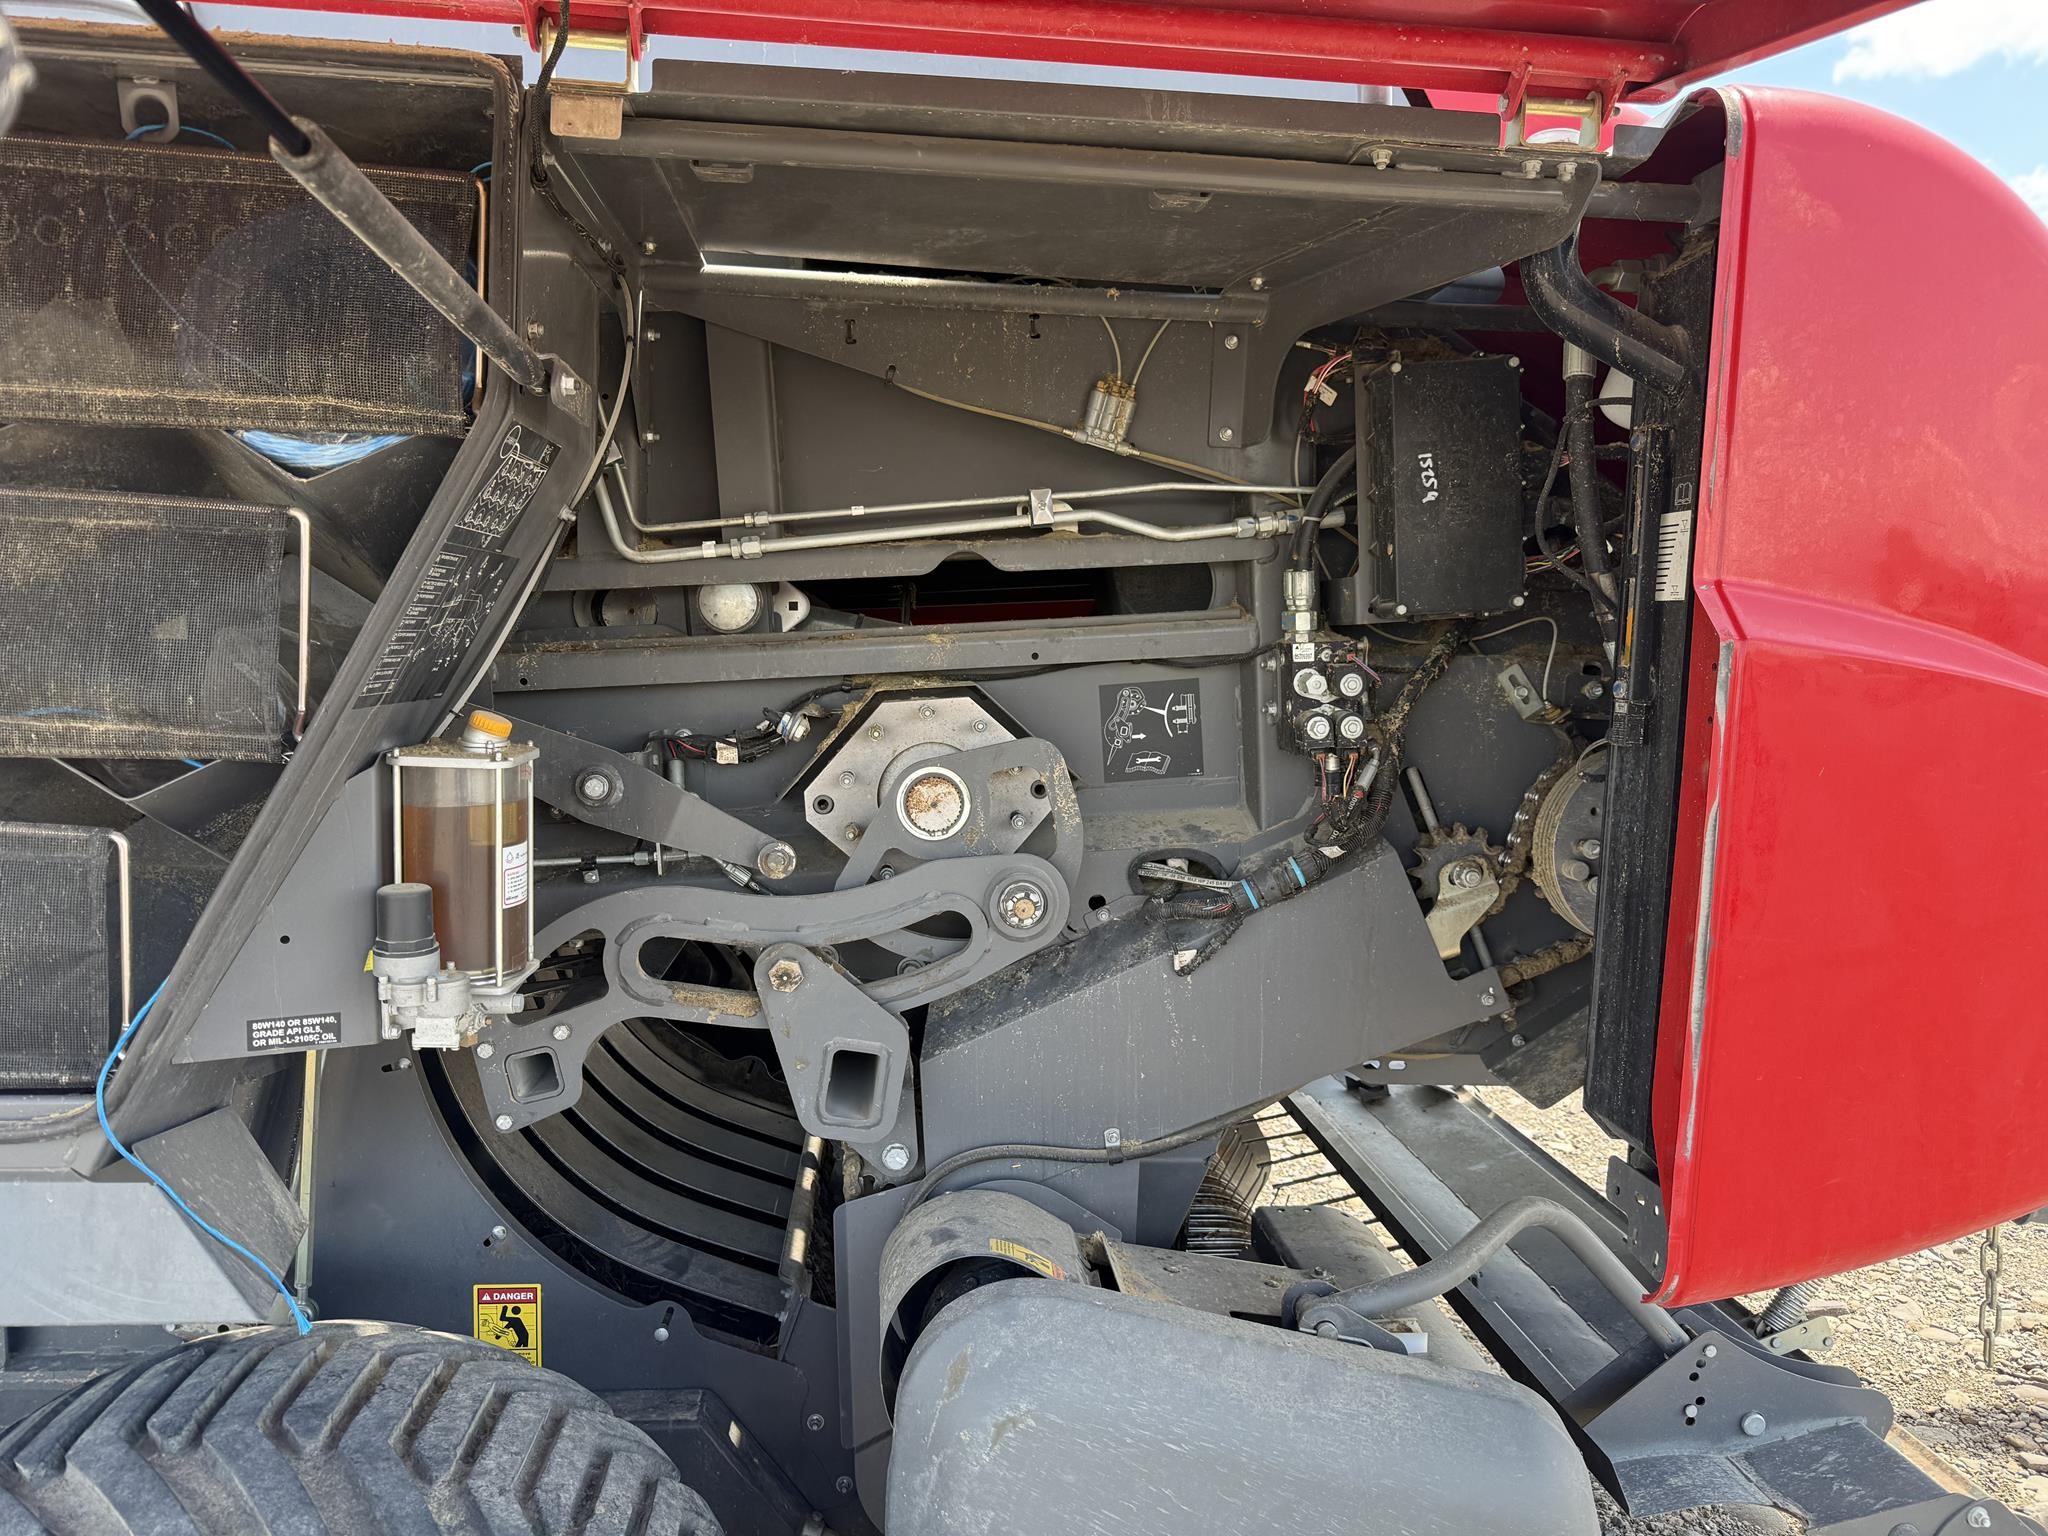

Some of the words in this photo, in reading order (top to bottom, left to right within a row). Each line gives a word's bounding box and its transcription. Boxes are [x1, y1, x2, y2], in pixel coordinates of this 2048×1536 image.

[252, 1021, 286, 1030] 80W140
[287, 1019, 301, 1027] OR
[302, 1016, 338, 1026] 85W140,
[252, 1029, 285, 1039] GRADE
[286, 1027, 302, 1036] API
[302, 1025, 323, 1035] GL5,
[252, 1039, 267, 1047] OR
[268, 1034, 320, 1046] MIL-L-2105C
[321, 1032, 337, 1041] OIL
[493, 1292, 534, 1301] DANGER
